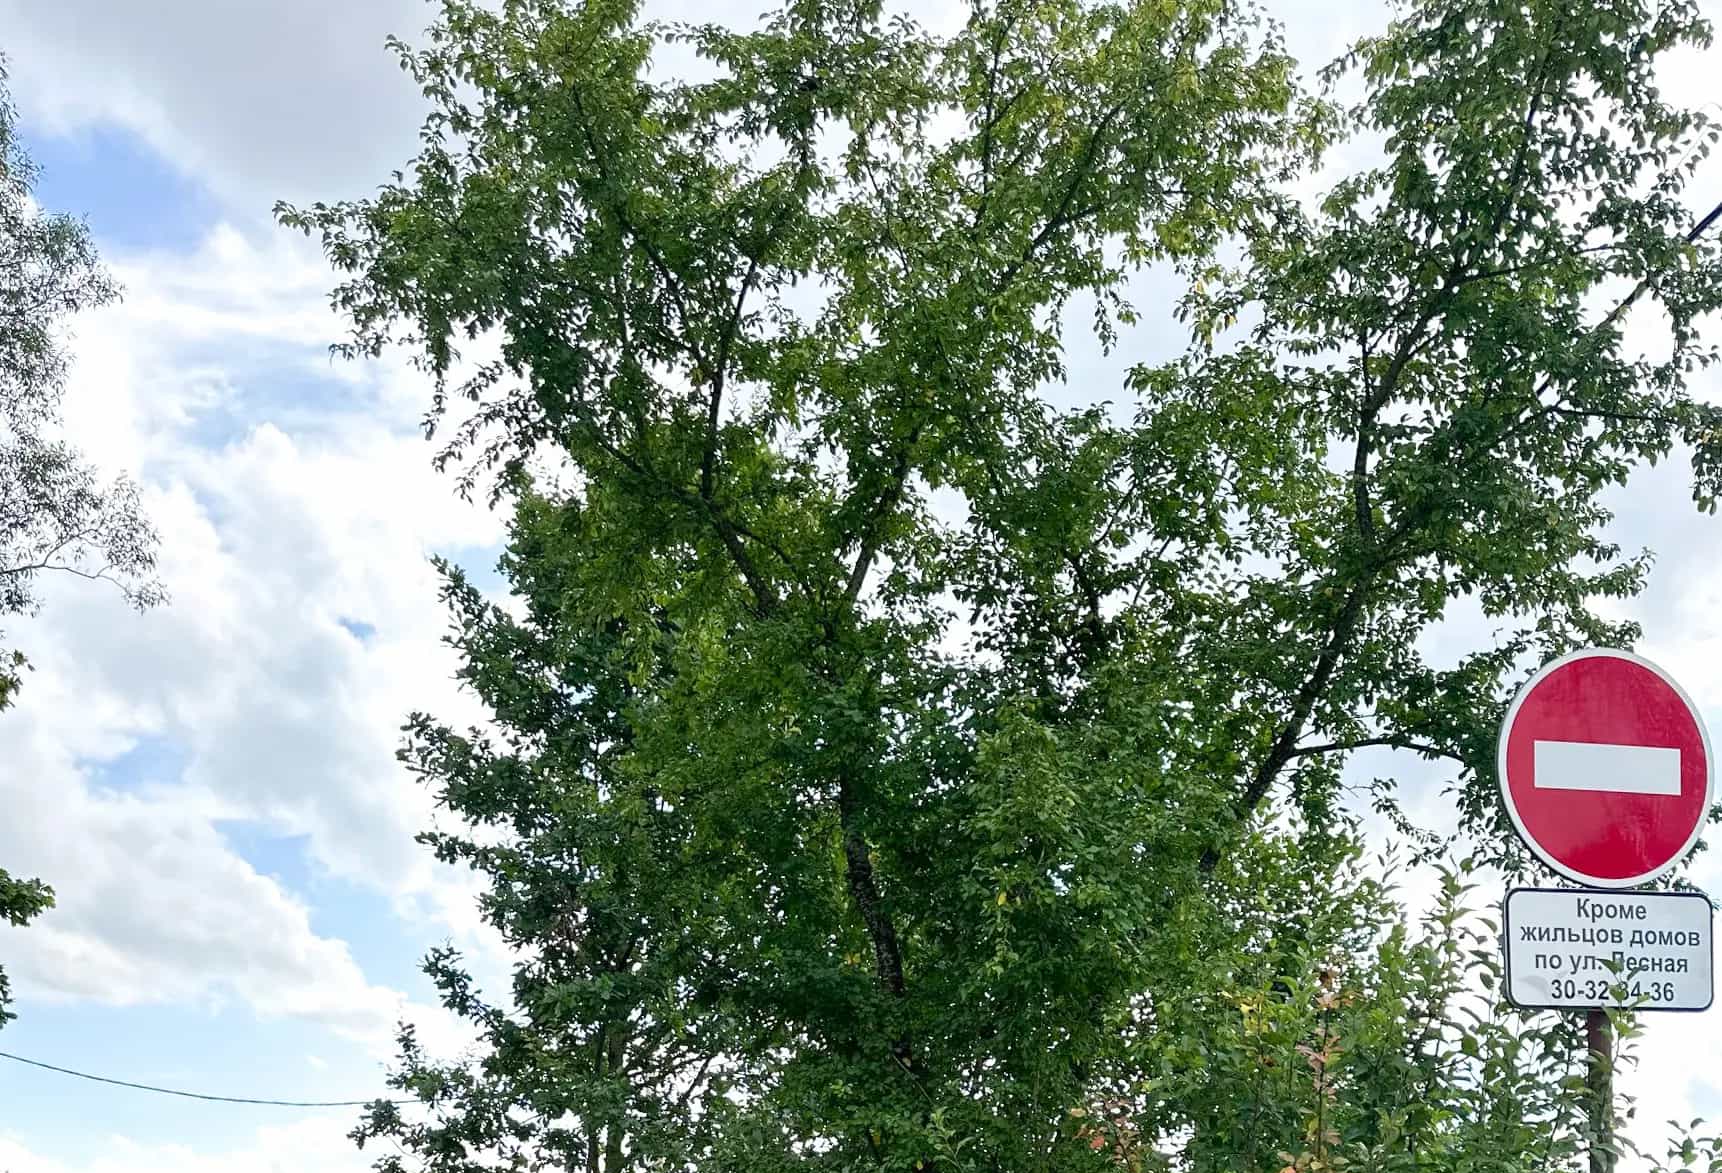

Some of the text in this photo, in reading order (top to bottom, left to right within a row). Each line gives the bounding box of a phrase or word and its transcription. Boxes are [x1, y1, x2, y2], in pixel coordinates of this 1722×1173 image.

[1577, 898, 1647, 922] Кроме
[1520, 926, 1700, 947] жильцов домов
[1535, 953, 1562, 970] по
[1570, 955, 1603, 974] ул.
[1551, 979, 1675, 1002] 30-3234-36
